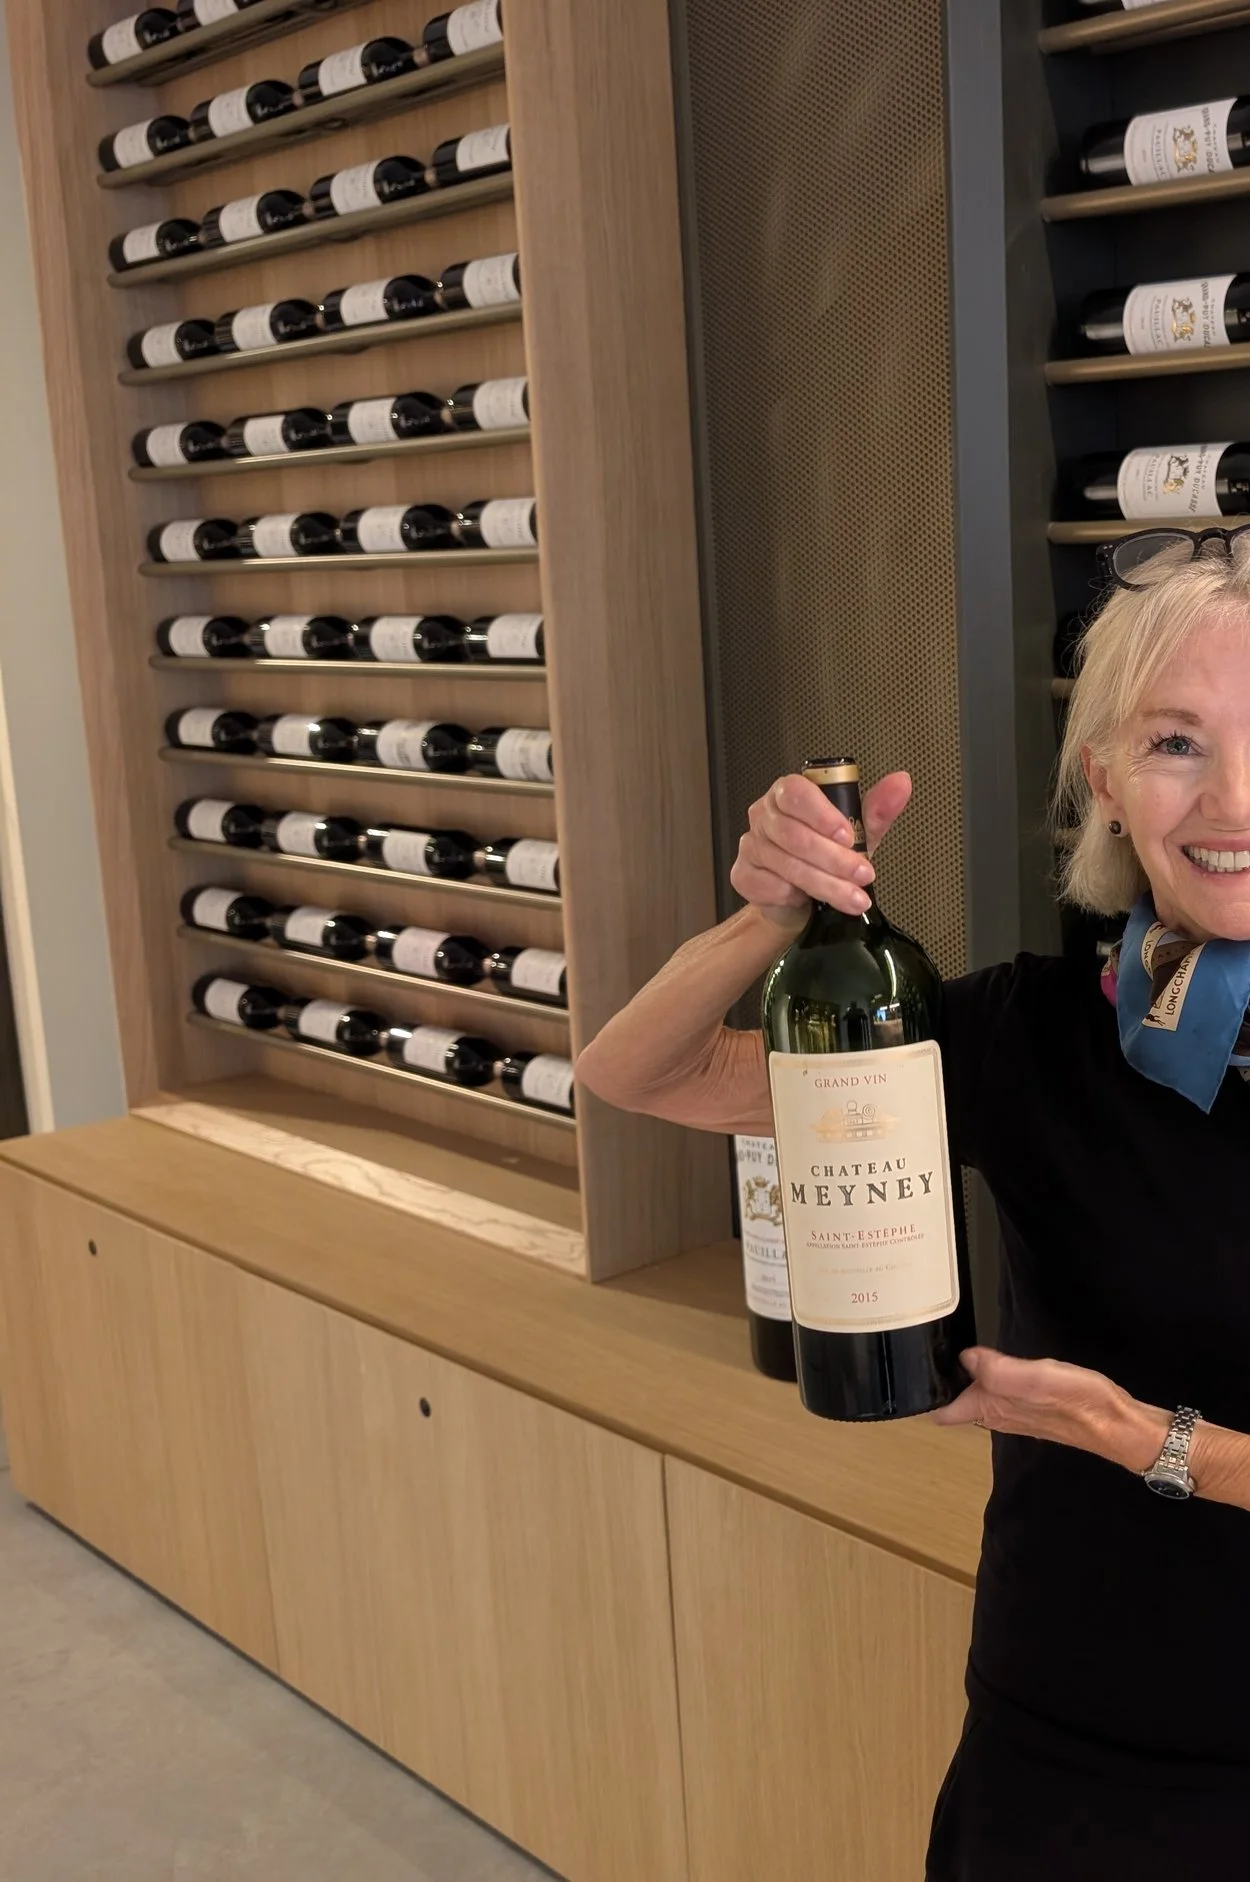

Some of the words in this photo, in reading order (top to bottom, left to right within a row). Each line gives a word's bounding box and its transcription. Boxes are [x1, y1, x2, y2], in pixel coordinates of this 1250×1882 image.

[1165, 956, 1193, 1016] LONGCHAM
[814, 1077, 859, 1088] GRAND
[864, 1074, 887, 1085] VIN
[811, 1158, 907, 1177] CHATEAU
[790, 1171, 933, 1206] MEYNEY
[746, 1243, 787, 1259] PAUILLA
[851, 1292, 878, 1303] 2015
